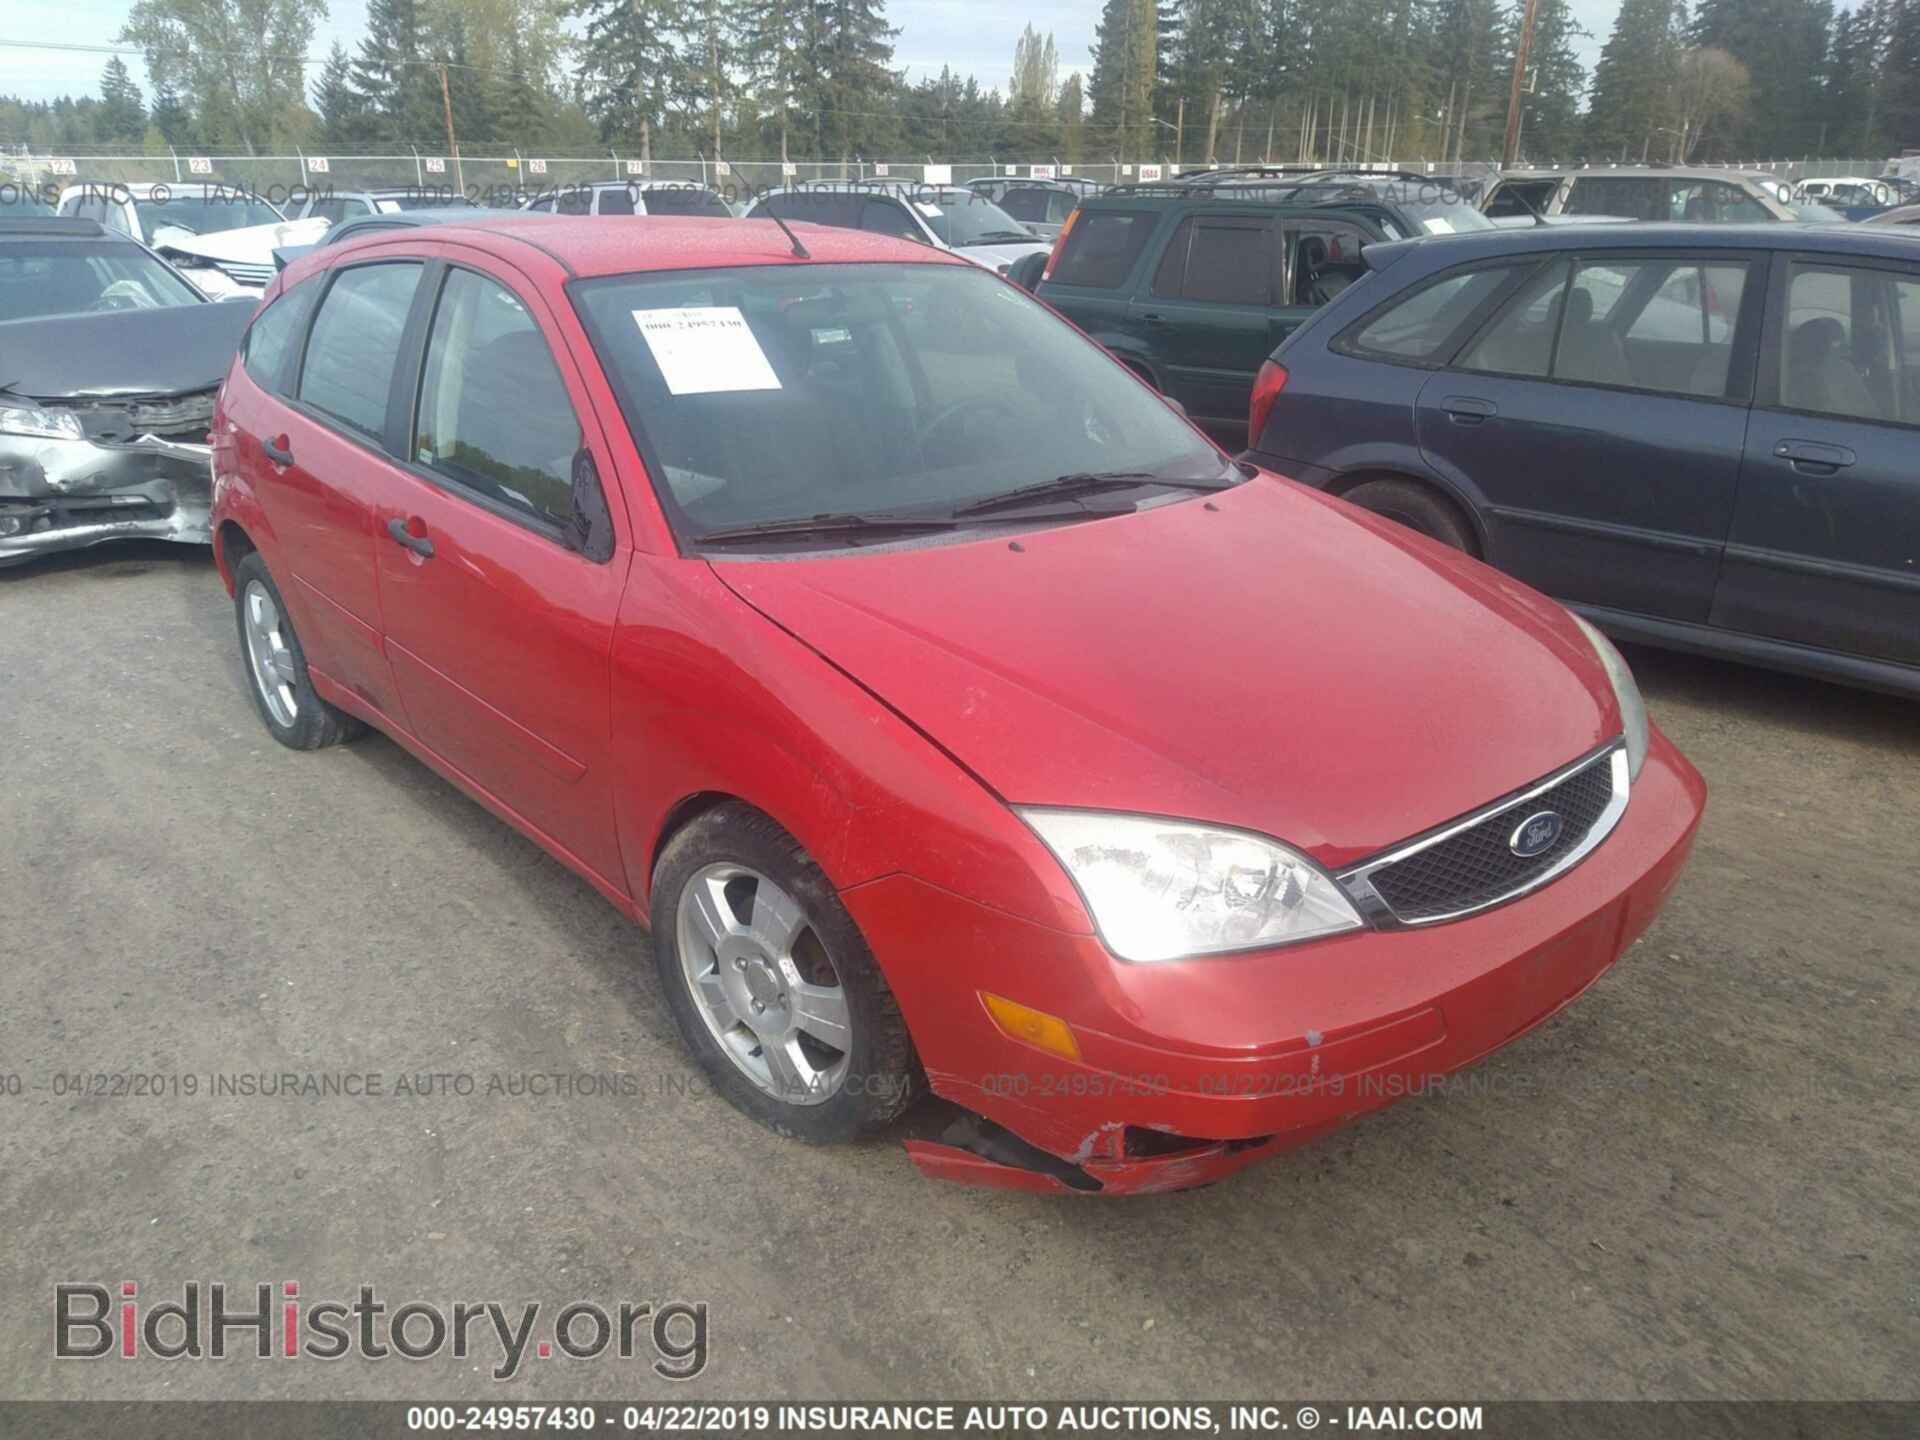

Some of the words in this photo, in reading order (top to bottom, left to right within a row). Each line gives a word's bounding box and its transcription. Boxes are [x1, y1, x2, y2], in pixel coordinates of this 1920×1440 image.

[54, 160, 73, 174] 22
[192, 160, 210, 172] 23
[311, 159, 326, 171] 24
[429, 160, 443, 172] 25
[1527, 820, 1553, 847] Ford
